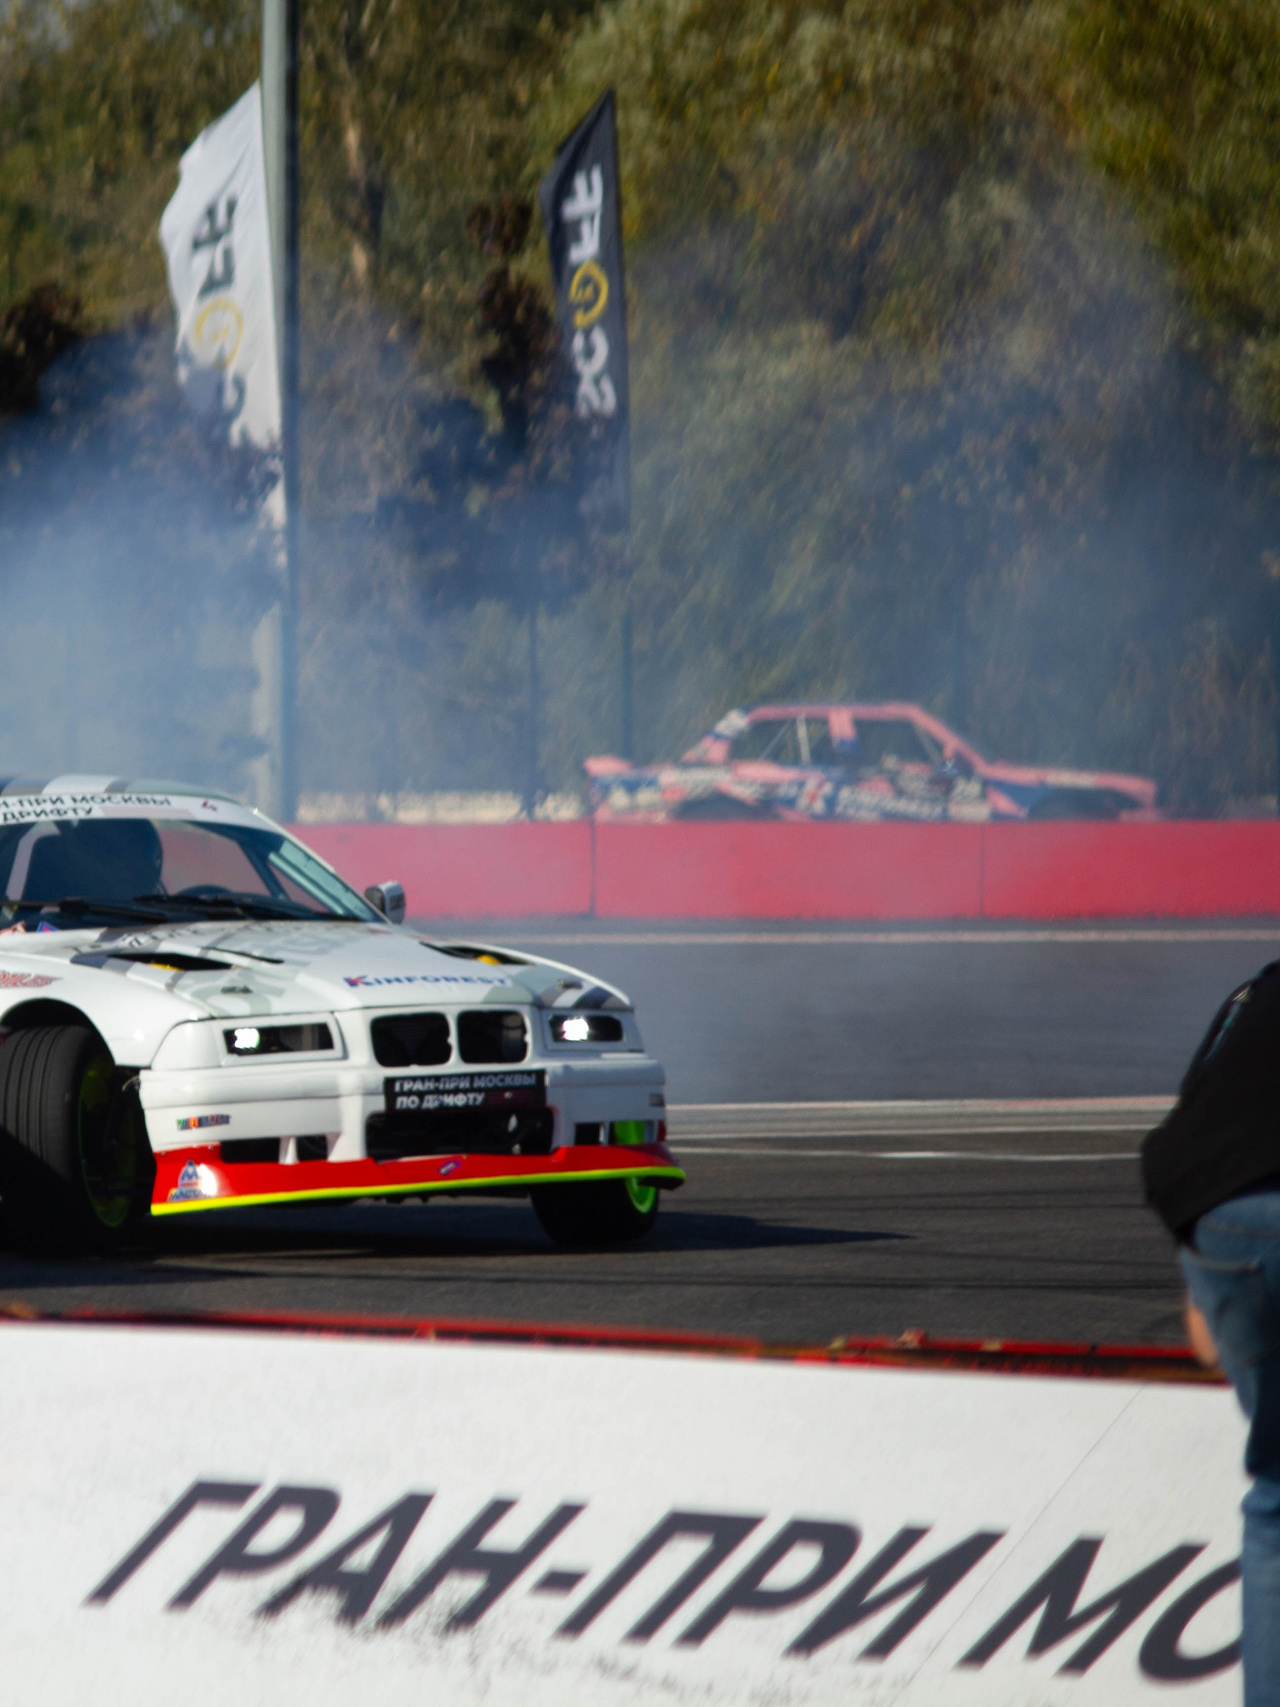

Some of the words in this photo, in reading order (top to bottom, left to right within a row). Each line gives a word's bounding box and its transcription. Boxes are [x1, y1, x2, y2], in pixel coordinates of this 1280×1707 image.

[71, 795, 171, 806] МОСКВЫ
[3, 806, 93, 823] ДРИФТУ
[342, 975, 507, 988] KINFOREST
[394, 1077, 470, 1093] ГРАН-ПРИ
[473, 1073, 536, 1089] МОСКВЫ
[395, 1095, 420, 1110] ПО
[421, 1092, 486, 1110] ДРИФТУ
[78, 1477, 1010, 1665] ГРАН-ПРИ
